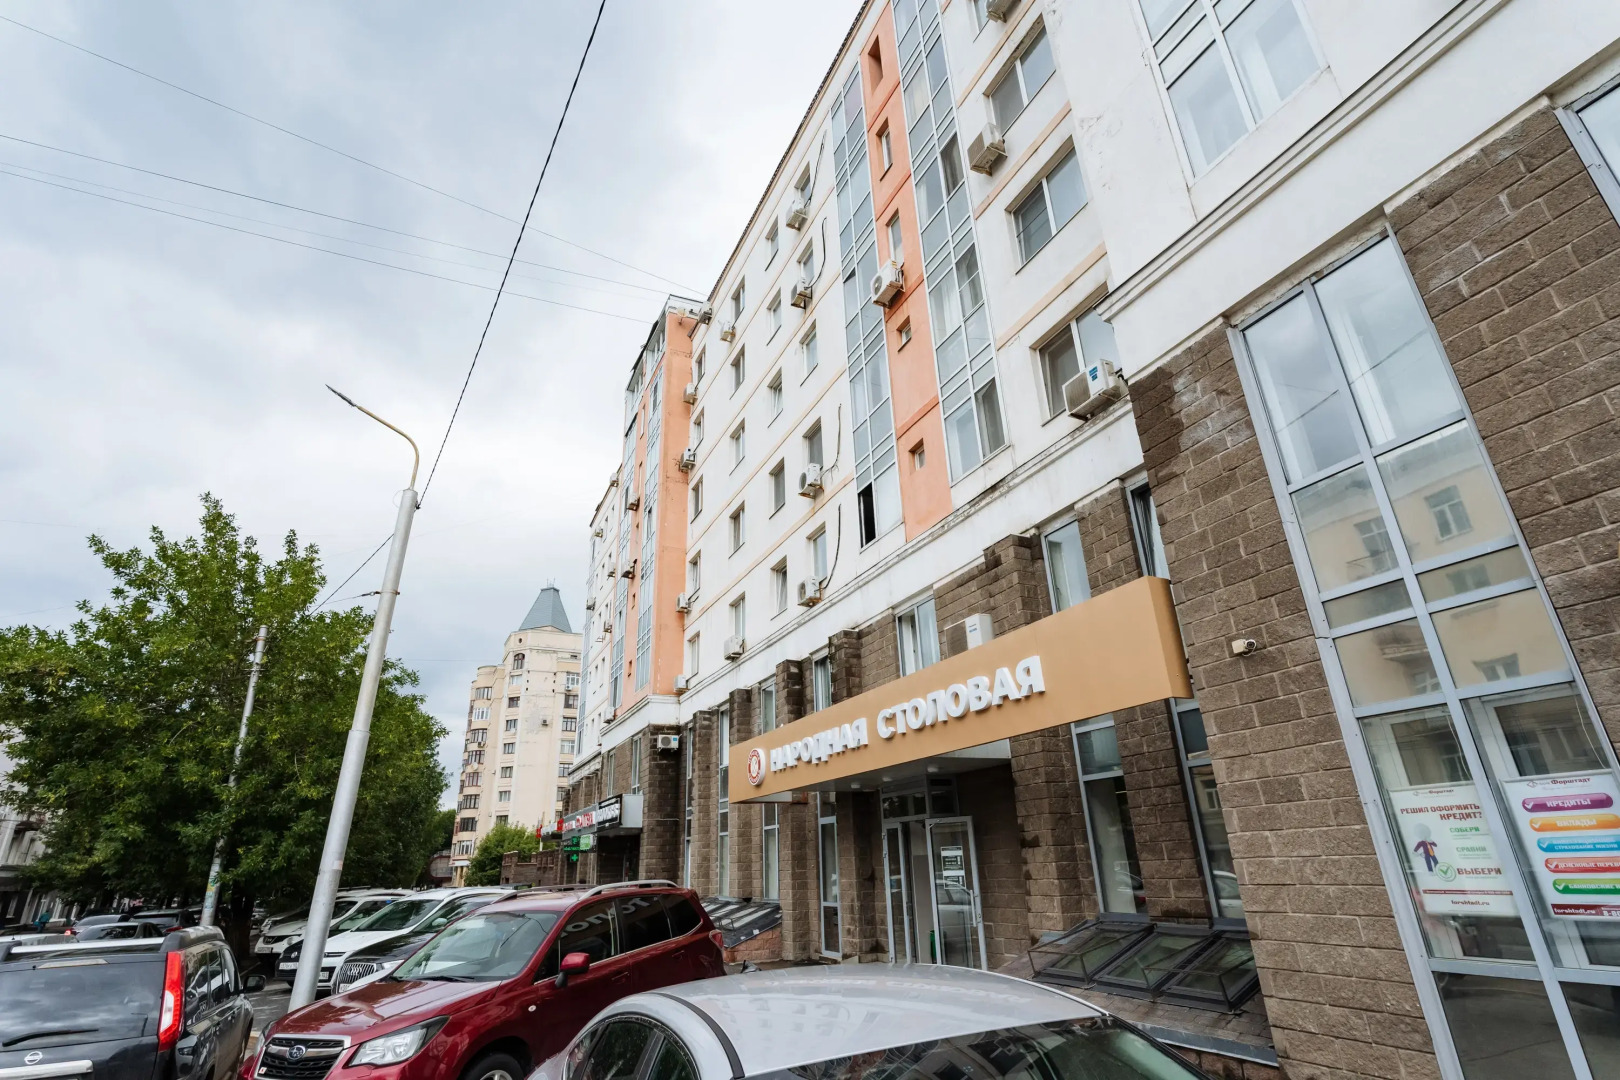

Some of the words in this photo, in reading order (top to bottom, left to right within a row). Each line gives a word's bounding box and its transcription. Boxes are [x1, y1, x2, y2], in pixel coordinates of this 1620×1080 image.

[770, 718, 868, 772] НАРОДНАЯ
[876, 655, 1046, 739] СТОЛОВАЯ
[1546, 798, 1591, 808] КРЕДИТЫ
[1400, 806, 1429, 815] РЕШИЛ
[1430, 803, 1480, 813] ОФОРМИТЬ
[1440, 811, 1482, 821] КРЕДИТ?
[1556, 818, 1597, 827] ВКЛАДЫ
[1457, 867, 1502, 875] ВЫБЕРИ
